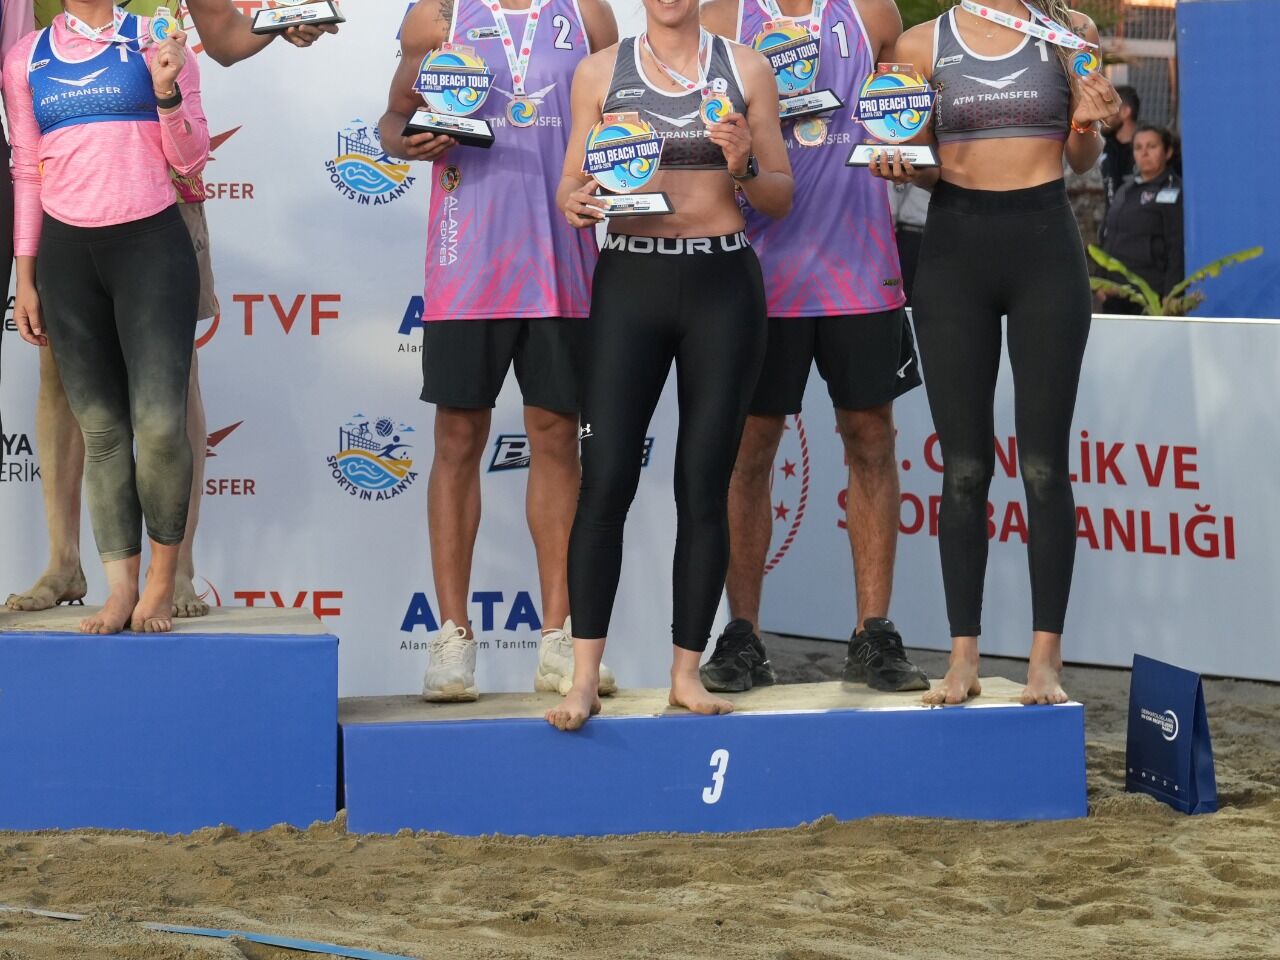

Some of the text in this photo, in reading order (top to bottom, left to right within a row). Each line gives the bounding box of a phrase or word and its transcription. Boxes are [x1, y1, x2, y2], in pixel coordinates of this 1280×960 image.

[552, 14, 574, 51] 2
[831, 21, 850, 59] 1
[115, 44, 129, 63] 1
[771, 42, 819, 67] BEACH TOUR
[1035, 39, 1049, 62] 1
[421, 73, 489, 88] PRO BEACH TOUR
[40, 86, 121, 107] ATM TRANSFER
[860, 94, 931, 113] PRO BEACH TOUR
[953, 90, 1038, 106] ATM TRANSFER
[587, 141, 660, 166] PRO BEACH TOUR
[325, 159, 416, 205] SPORTS IN ALANYA
[447, 195, 459, 266] ALANYA
[603, 233, 713, 256] MOUR
[232, 294, 341, 336] TVF
[326, 455, 419, 501] SPORTS IN ALANYA
[1135, 444, 1200, 490] VE
[495, 639, 538, 649] Tanıtm
[702, 748, 730, 805] 3
